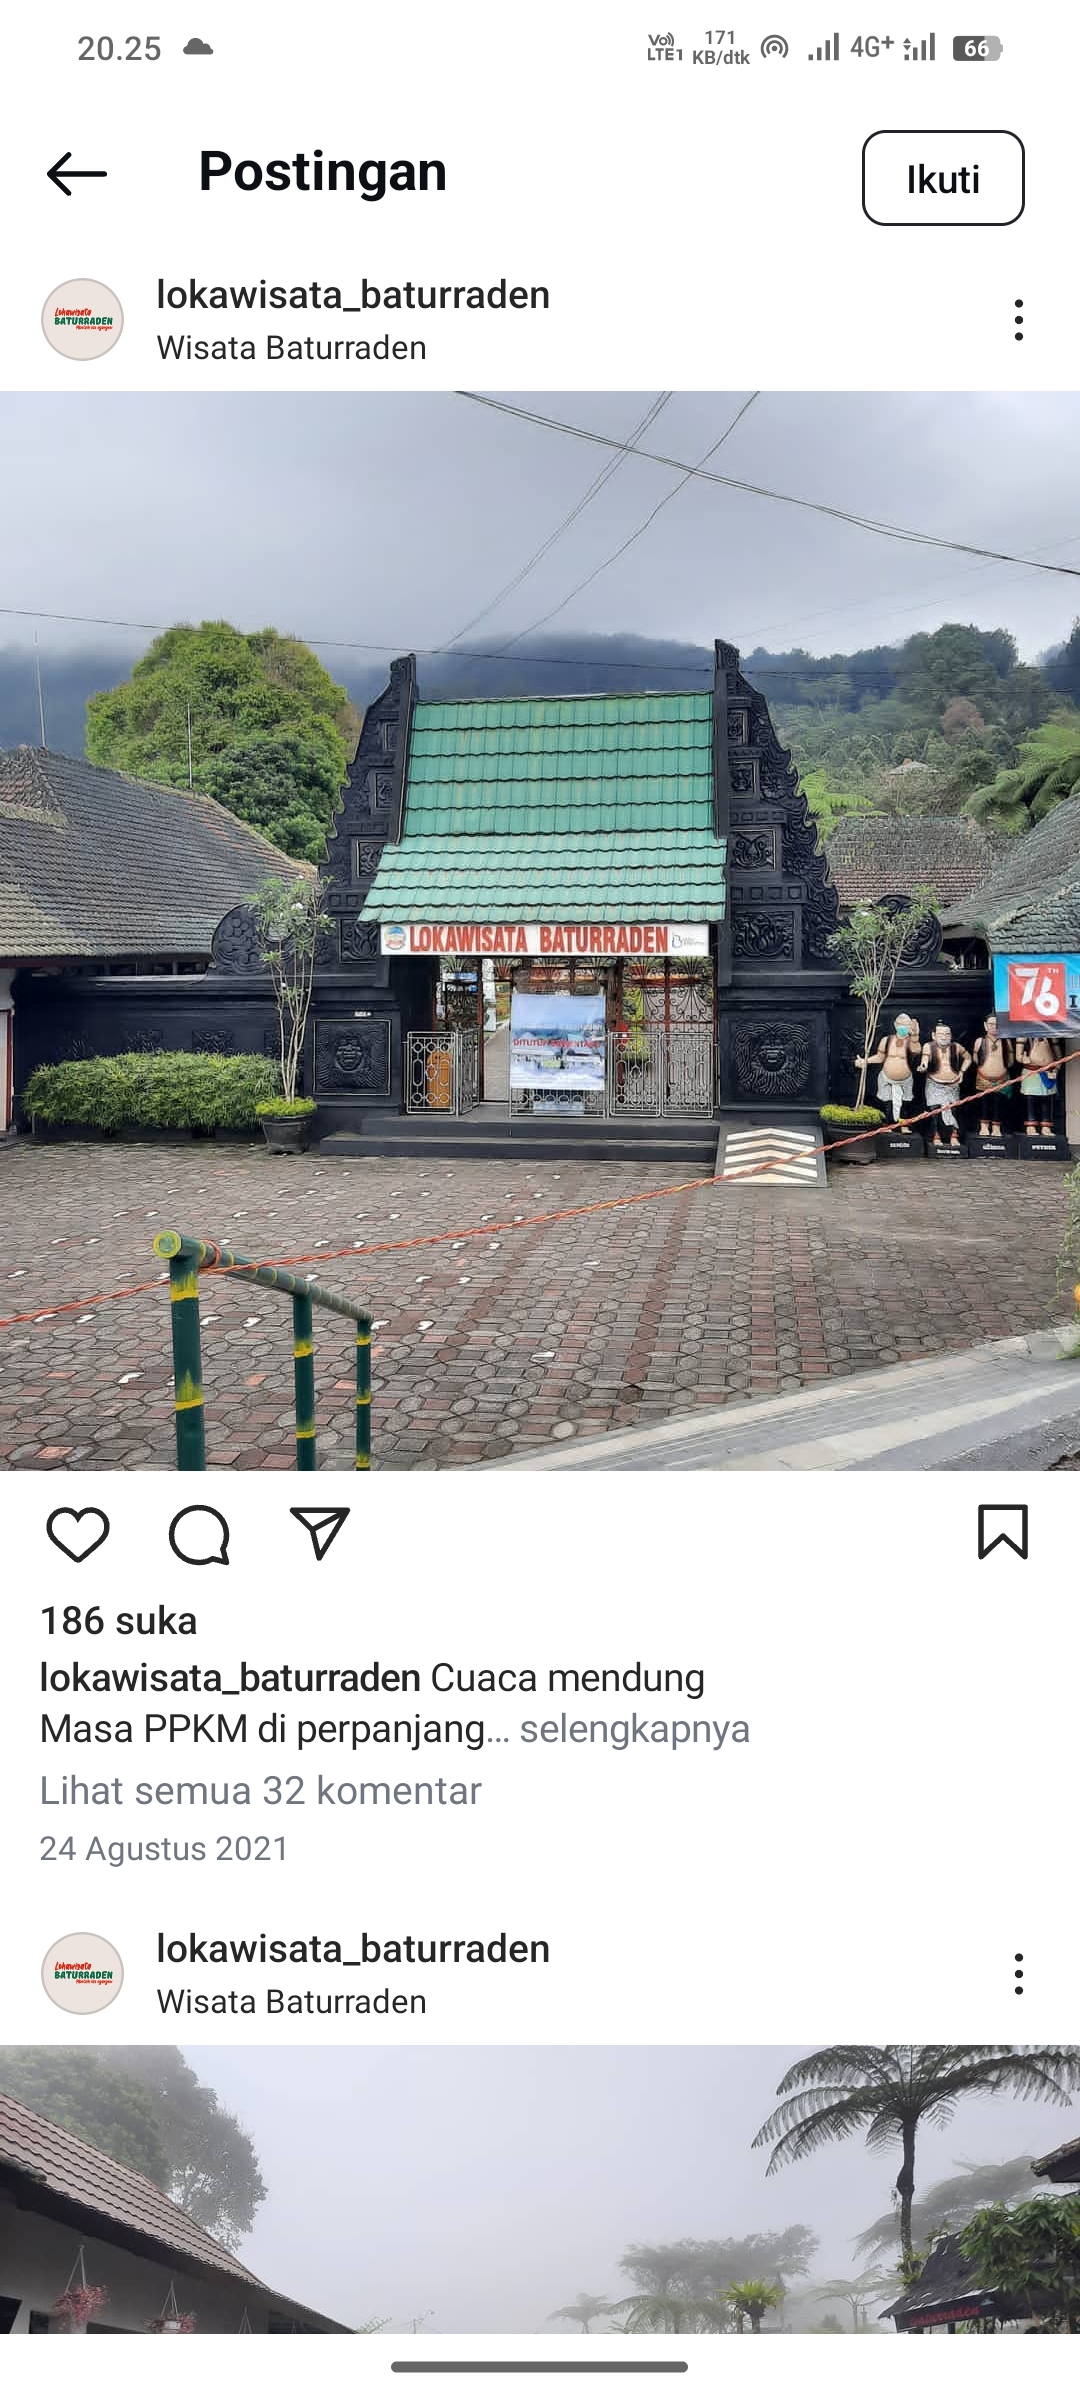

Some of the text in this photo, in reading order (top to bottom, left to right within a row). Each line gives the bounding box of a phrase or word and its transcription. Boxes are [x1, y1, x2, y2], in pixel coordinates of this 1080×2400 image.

[78, 36, 160, 60] 20.25
[705, 31, 735, 45] 171
[851, 36, 894, 57] 4G+
[964, 40, 990, 57] 66
[693, 50, 750, 65] KB/dtk
[201, 149, 445, 202] Postingan
[909, 164, 979, 193] Ikuti
[159, 279, 549, 312] lokawisata_baturraden
[54, 317, 113, 325] BATURRADEN
[157, 334, 425, 359] Wisata Baturraden
[409, 926, 528, 952] LOKAWISATA
[540, 926, 668, 952] BATURRADEN
[1014, 967, 1060, 1016] 76
[42, 1605, 196, 1634] 186 suka
[42, 1662, 703, 1699] lokawisata_baturraden Cuaca mendung
[42, 1714, 132, 1742] Masa
[146, 1714, 246, 1742] PPKM
[259, 1713, 285, 1742] di
[521, 1713, 749, 1750] selengkapnya
[42, 1775, 482, 1804] Lihat semua 32 komentar
[41, 1836, 287, 1867] 24 Agustus 2021
[159, 1932, 549, 1966] lokawisata_baturraden
[54, 1970, 113, 1978] BATURRADEN
[157, 1988, 425, 2013] Wisata Baturraden
